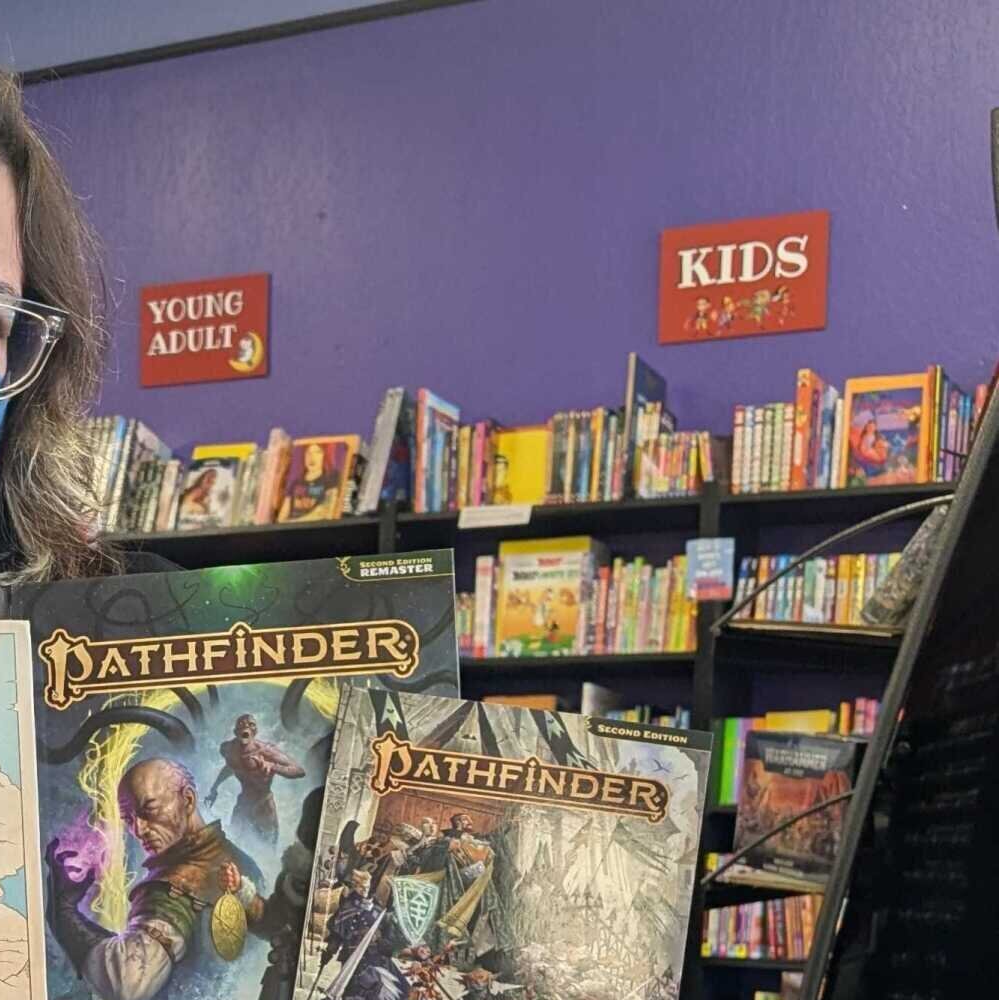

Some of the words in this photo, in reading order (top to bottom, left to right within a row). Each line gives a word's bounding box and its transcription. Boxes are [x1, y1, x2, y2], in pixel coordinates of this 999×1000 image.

[677, 234, 808, 289] KIDS
[147, 290, 244, 324] YOUNG
[147, 324, 238, 356] ADULT
[359, 560, 395, 568] SECOND
[396, 557, 433, 566] EDITION
[360, 563, 434, 577] REMASTER
[45, 624, 413, 705] PATHFINDER
[598, 723, 641, 738] SECOND
[643, 731, 689, 744] EDITION
[376, 736, 662, 813] PATHFINDER
